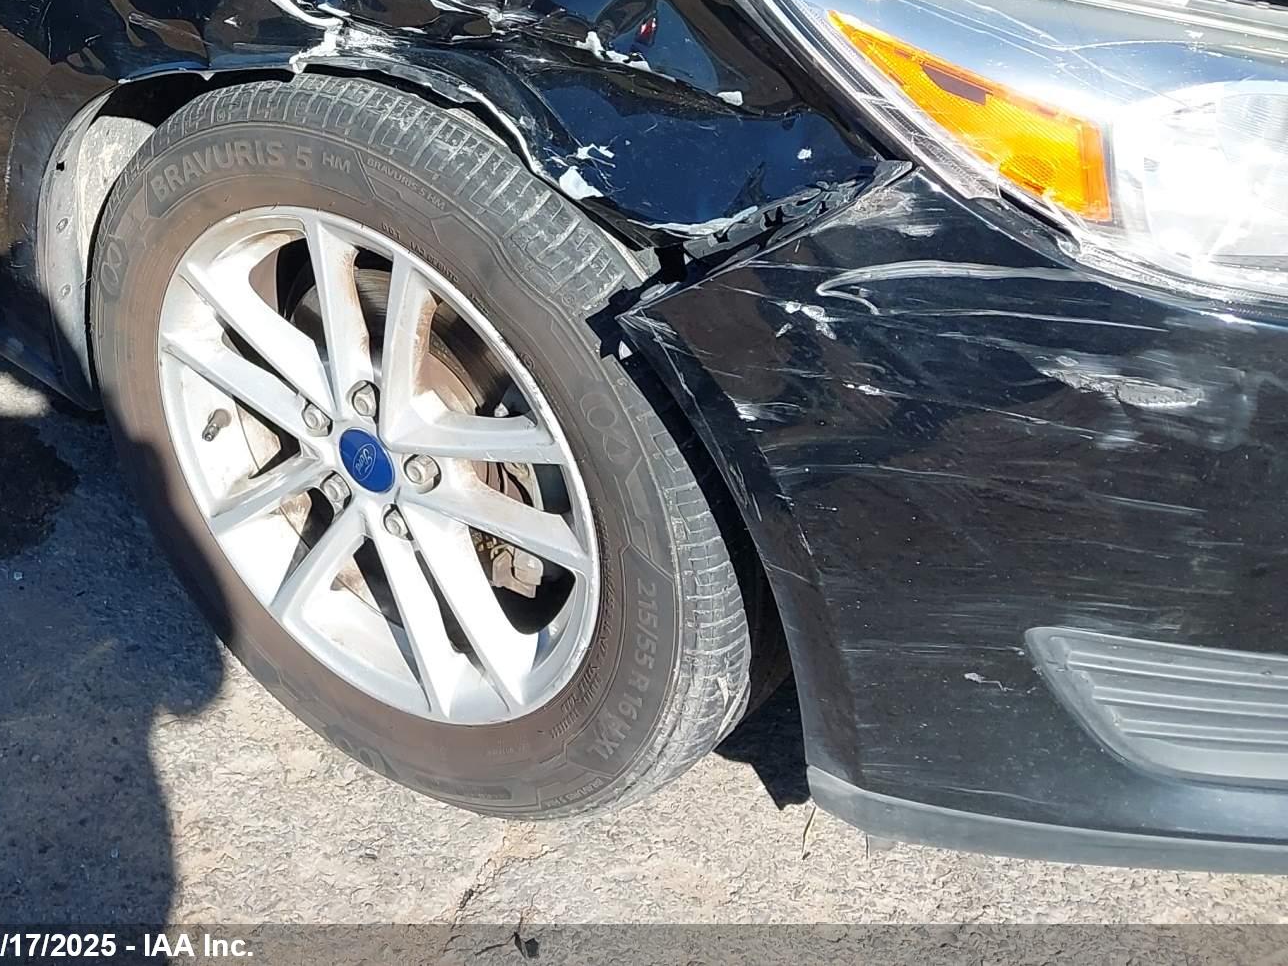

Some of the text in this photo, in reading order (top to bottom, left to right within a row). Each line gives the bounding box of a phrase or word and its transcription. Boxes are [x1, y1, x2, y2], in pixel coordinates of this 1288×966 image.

[150, 139, 352, 202] BRAVURIS 5 HM
[634, 577, 659, 670] 215/55
[618, 692, 643, 721] 16
